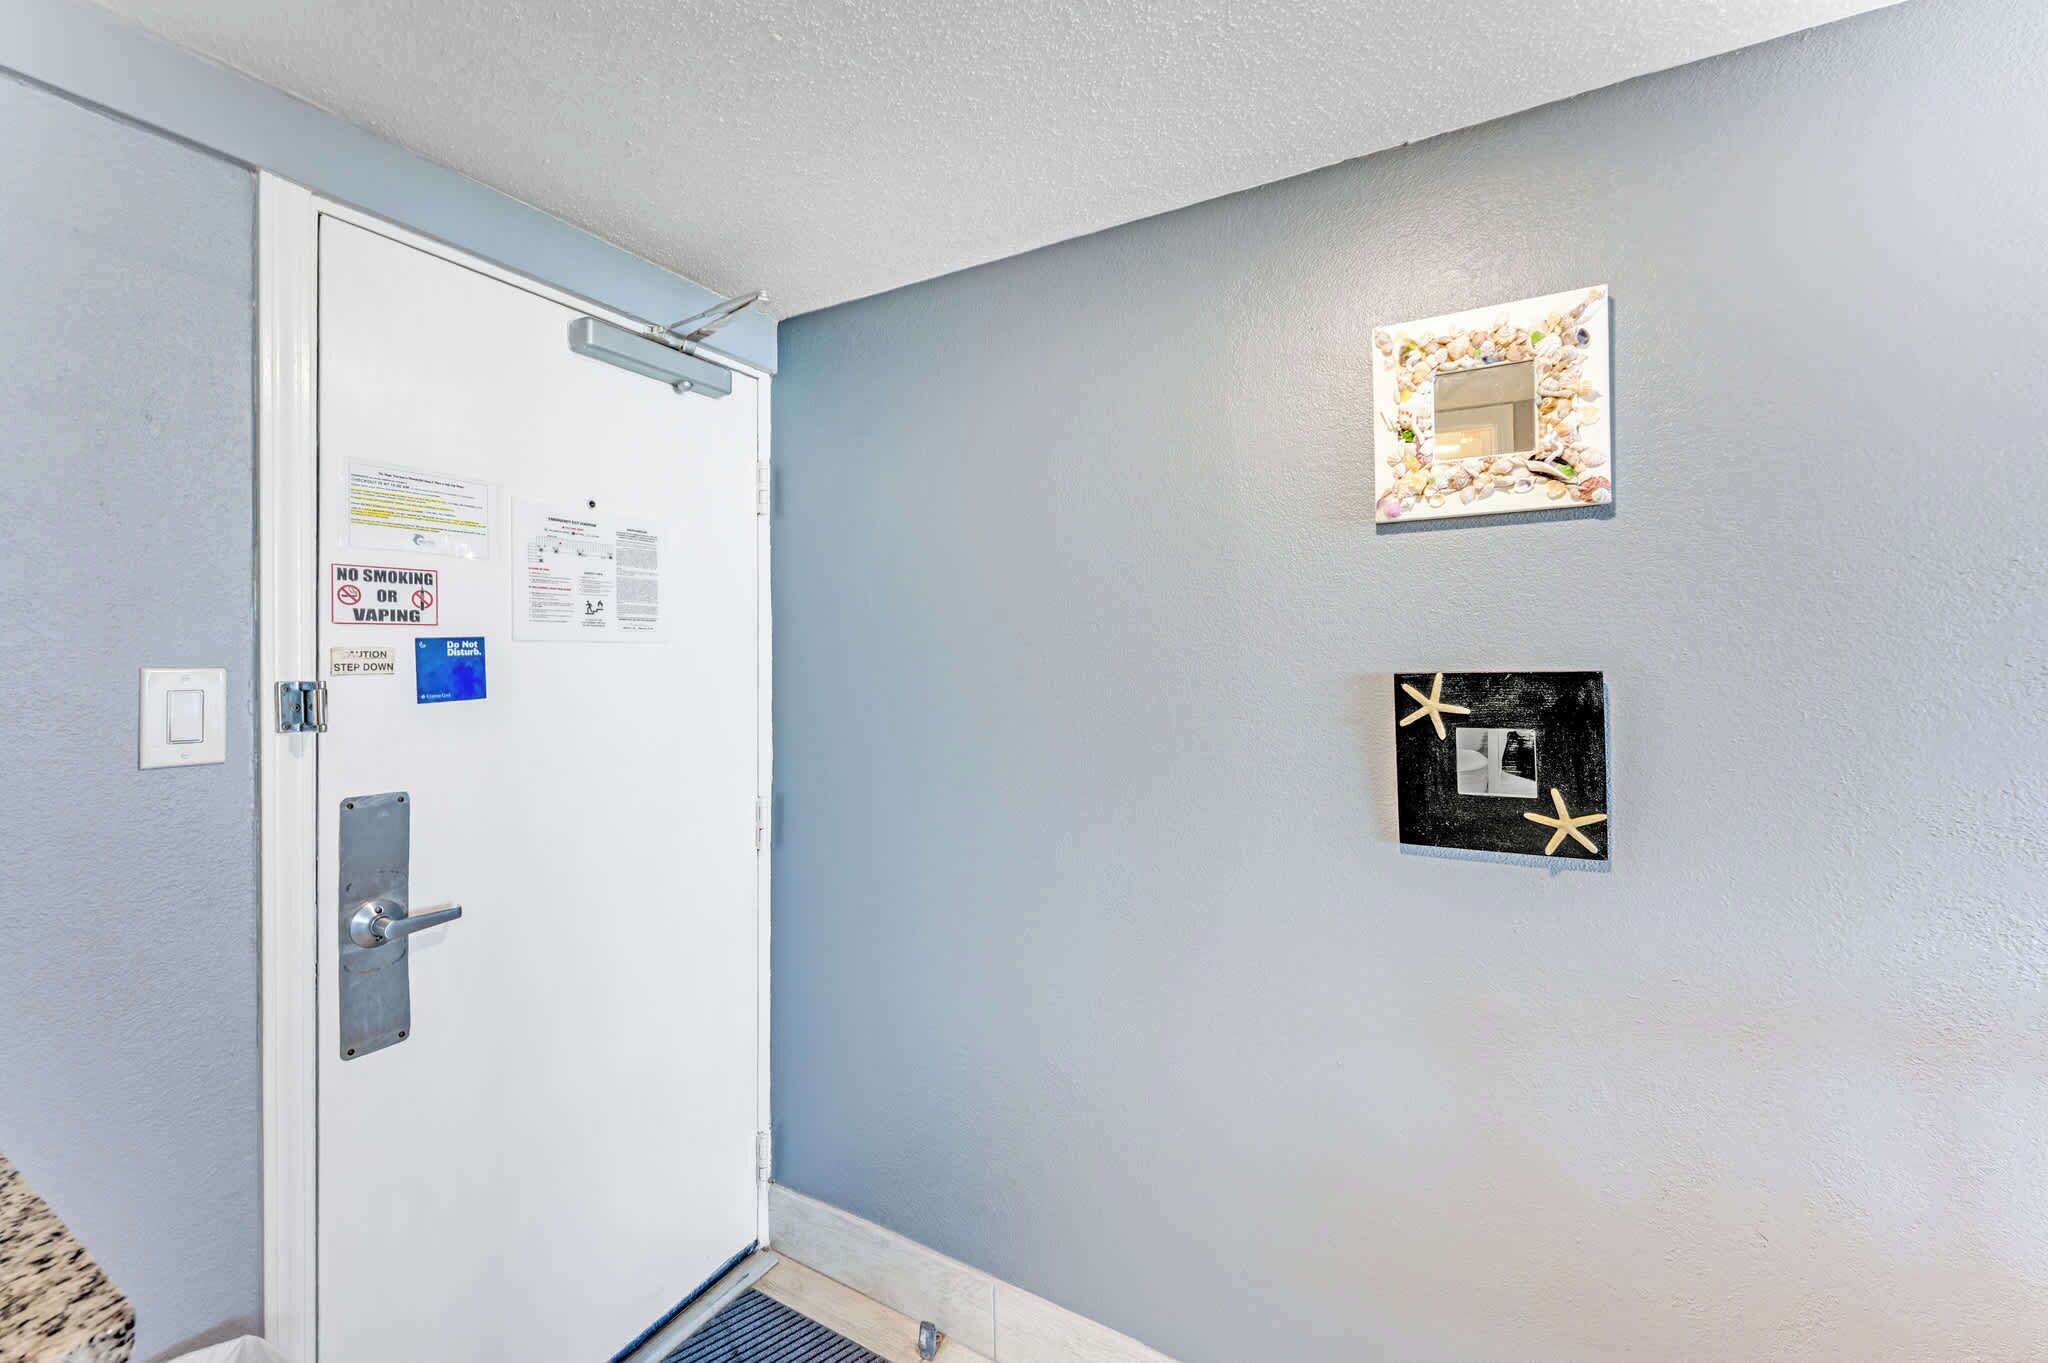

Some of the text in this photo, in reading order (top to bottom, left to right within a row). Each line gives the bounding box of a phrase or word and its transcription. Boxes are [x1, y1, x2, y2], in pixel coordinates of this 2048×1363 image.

[336, 567, 434, 586] NO SMOKING
[376, 589, 398, 603] OR
[352, 608, 421, 622] VAPING
[446, 640, 478, 648] Do Not
[446, 648, 482, 656] Disturb.
[333, 662, 394, 672] STEP DOWN
